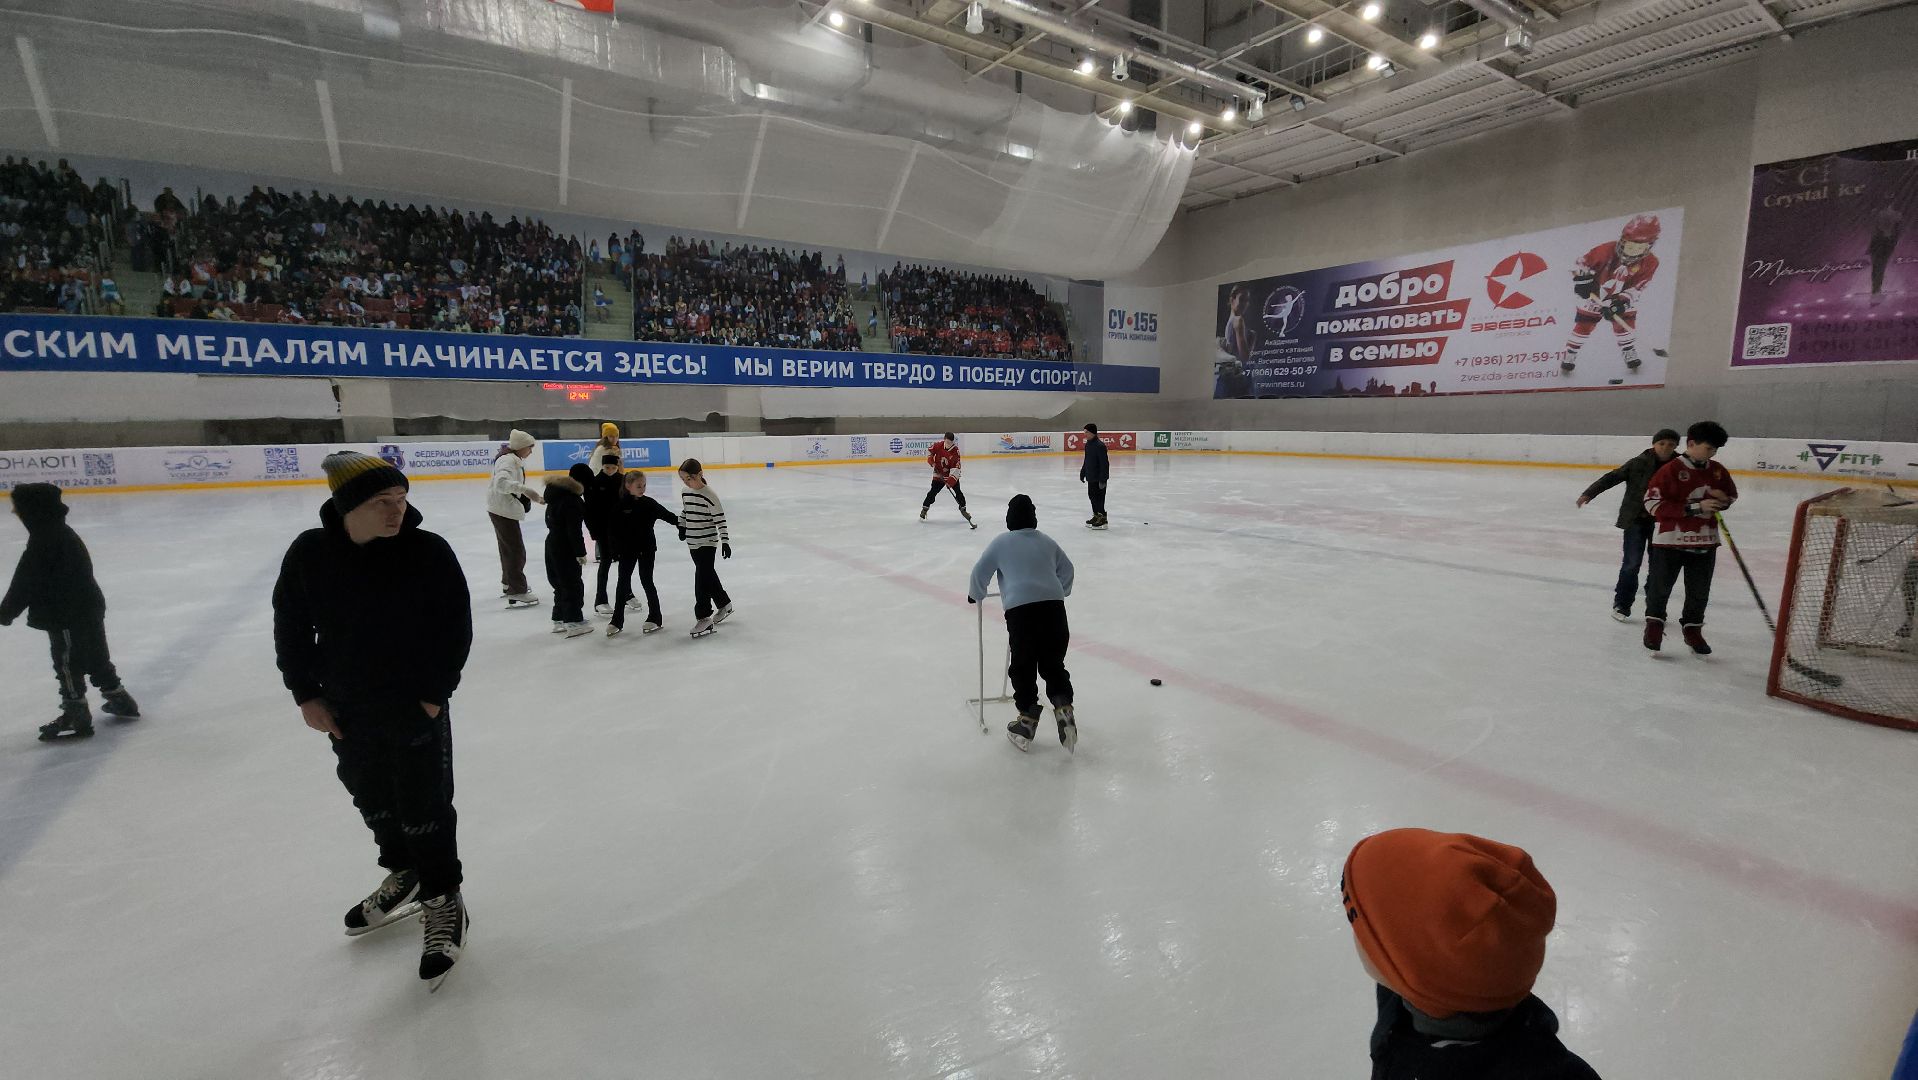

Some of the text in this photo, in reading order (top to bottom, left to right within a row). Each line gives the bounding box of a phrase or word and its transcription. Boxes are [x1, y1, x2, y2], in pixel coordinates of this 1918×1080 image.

[1334, 272, 1444, 309] добро
[1316, 308, 1462, 335] пожаловать
[156, 333, 368, 368] МЕДАЛЯМ
[383, 342, 604, 373] НАЧИНАЕТСЯ
[614, 351, 707, 378] ЗДЕСЬ!
[1329, 341, 1439, 362] в семью
[1455, 351, 1568, 368] +7 (936) 217-59-11
[734, 357, 1092, 387] МЫ ВЕРИМ ТВЕРДО В ПОБЕДУ СПОРТА!
[1460, 369, 1559, 382] zvezda-arena.ru
[409, 458, 496, 468] МОСКОВСКОЙ ОБЛАСТИ
[414, 449, 489, 458] ФЕДЕРАЦИЯ ХОККЕЯ
